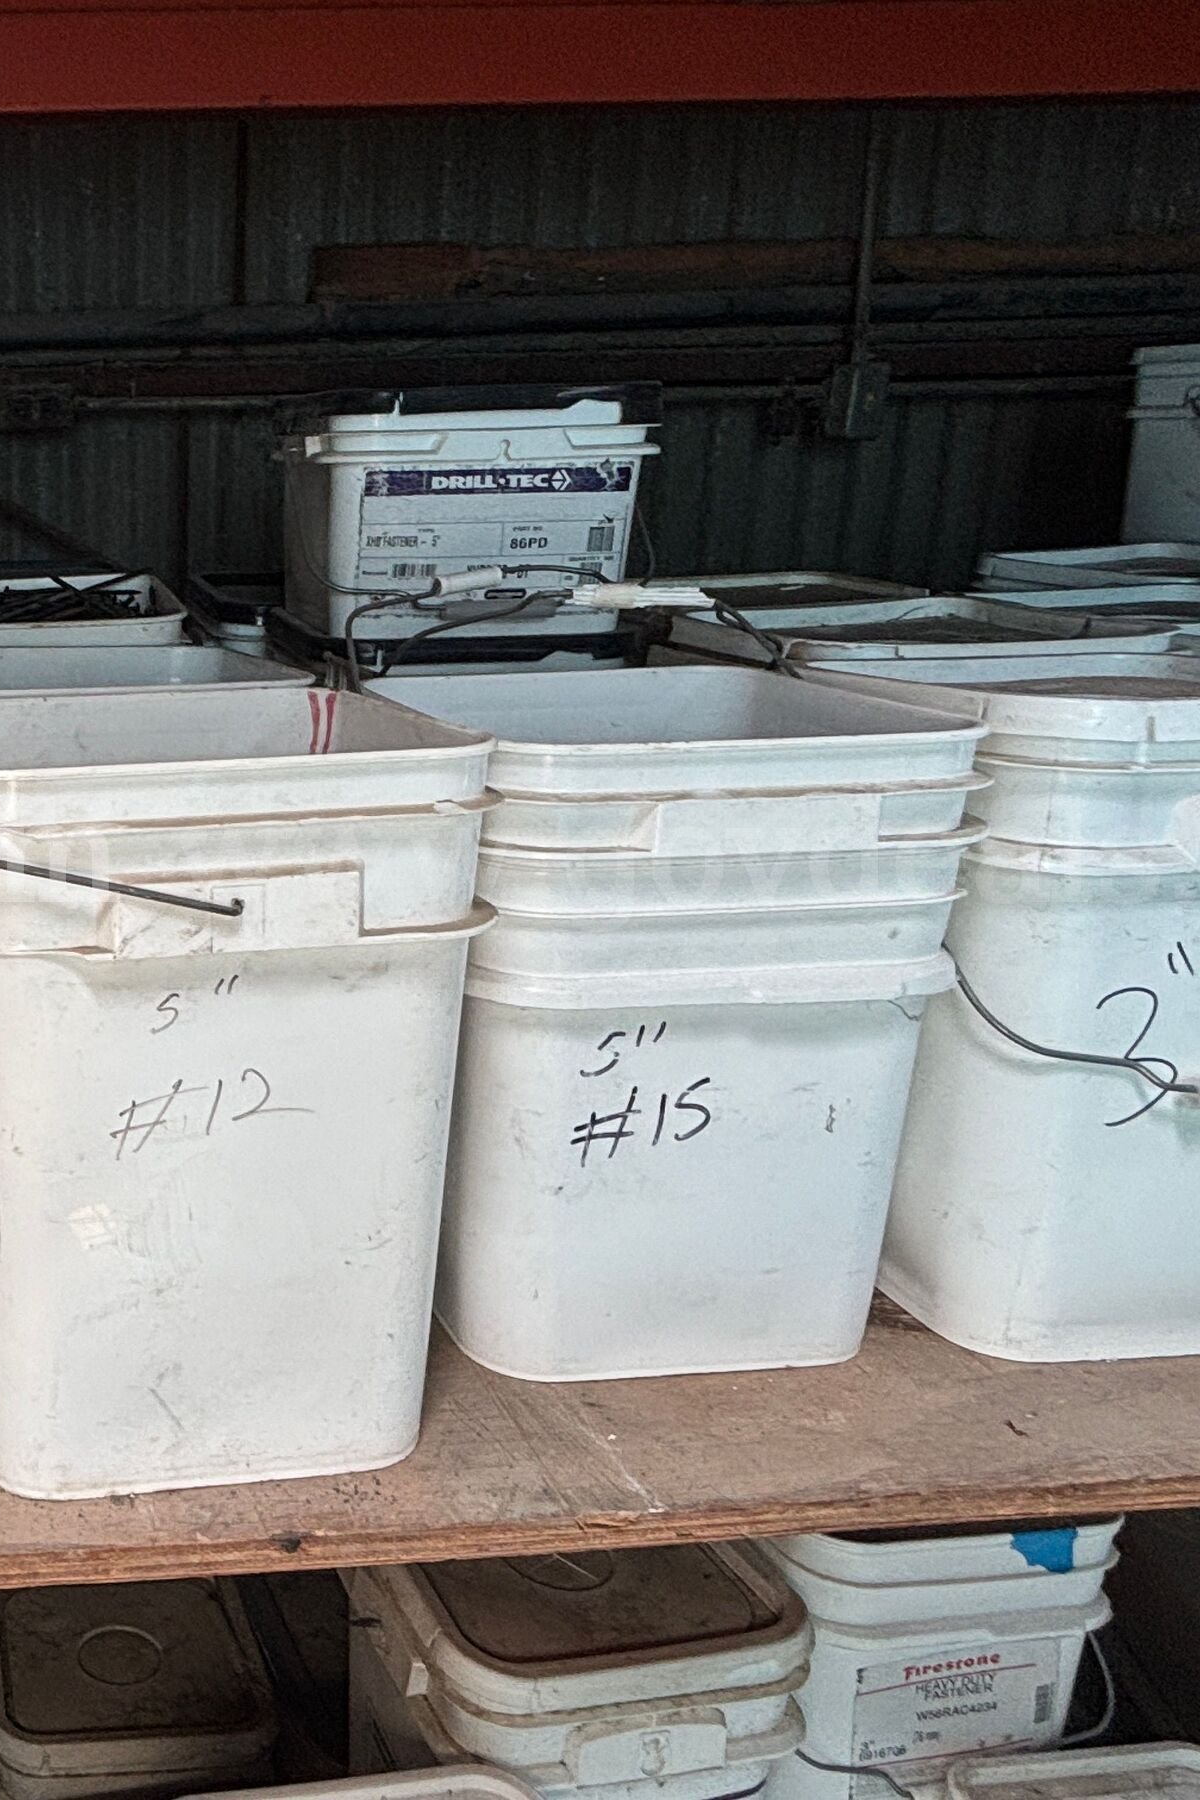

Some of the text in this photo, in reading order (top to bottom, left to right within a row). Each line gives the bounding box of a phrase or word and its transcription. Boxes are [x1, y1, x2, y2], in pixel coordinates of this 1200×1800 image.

[510, 537, 549, 550] 86PD
[109, 1067, 315, 1161] #12
[570, 1077, 711, 1168] #15
[903, 1653, 1001, 1681] Firestone
[915, 1672, 997, 1694] HEAVY DUTY
[924, 1683, 994, 1701] FASTENER
